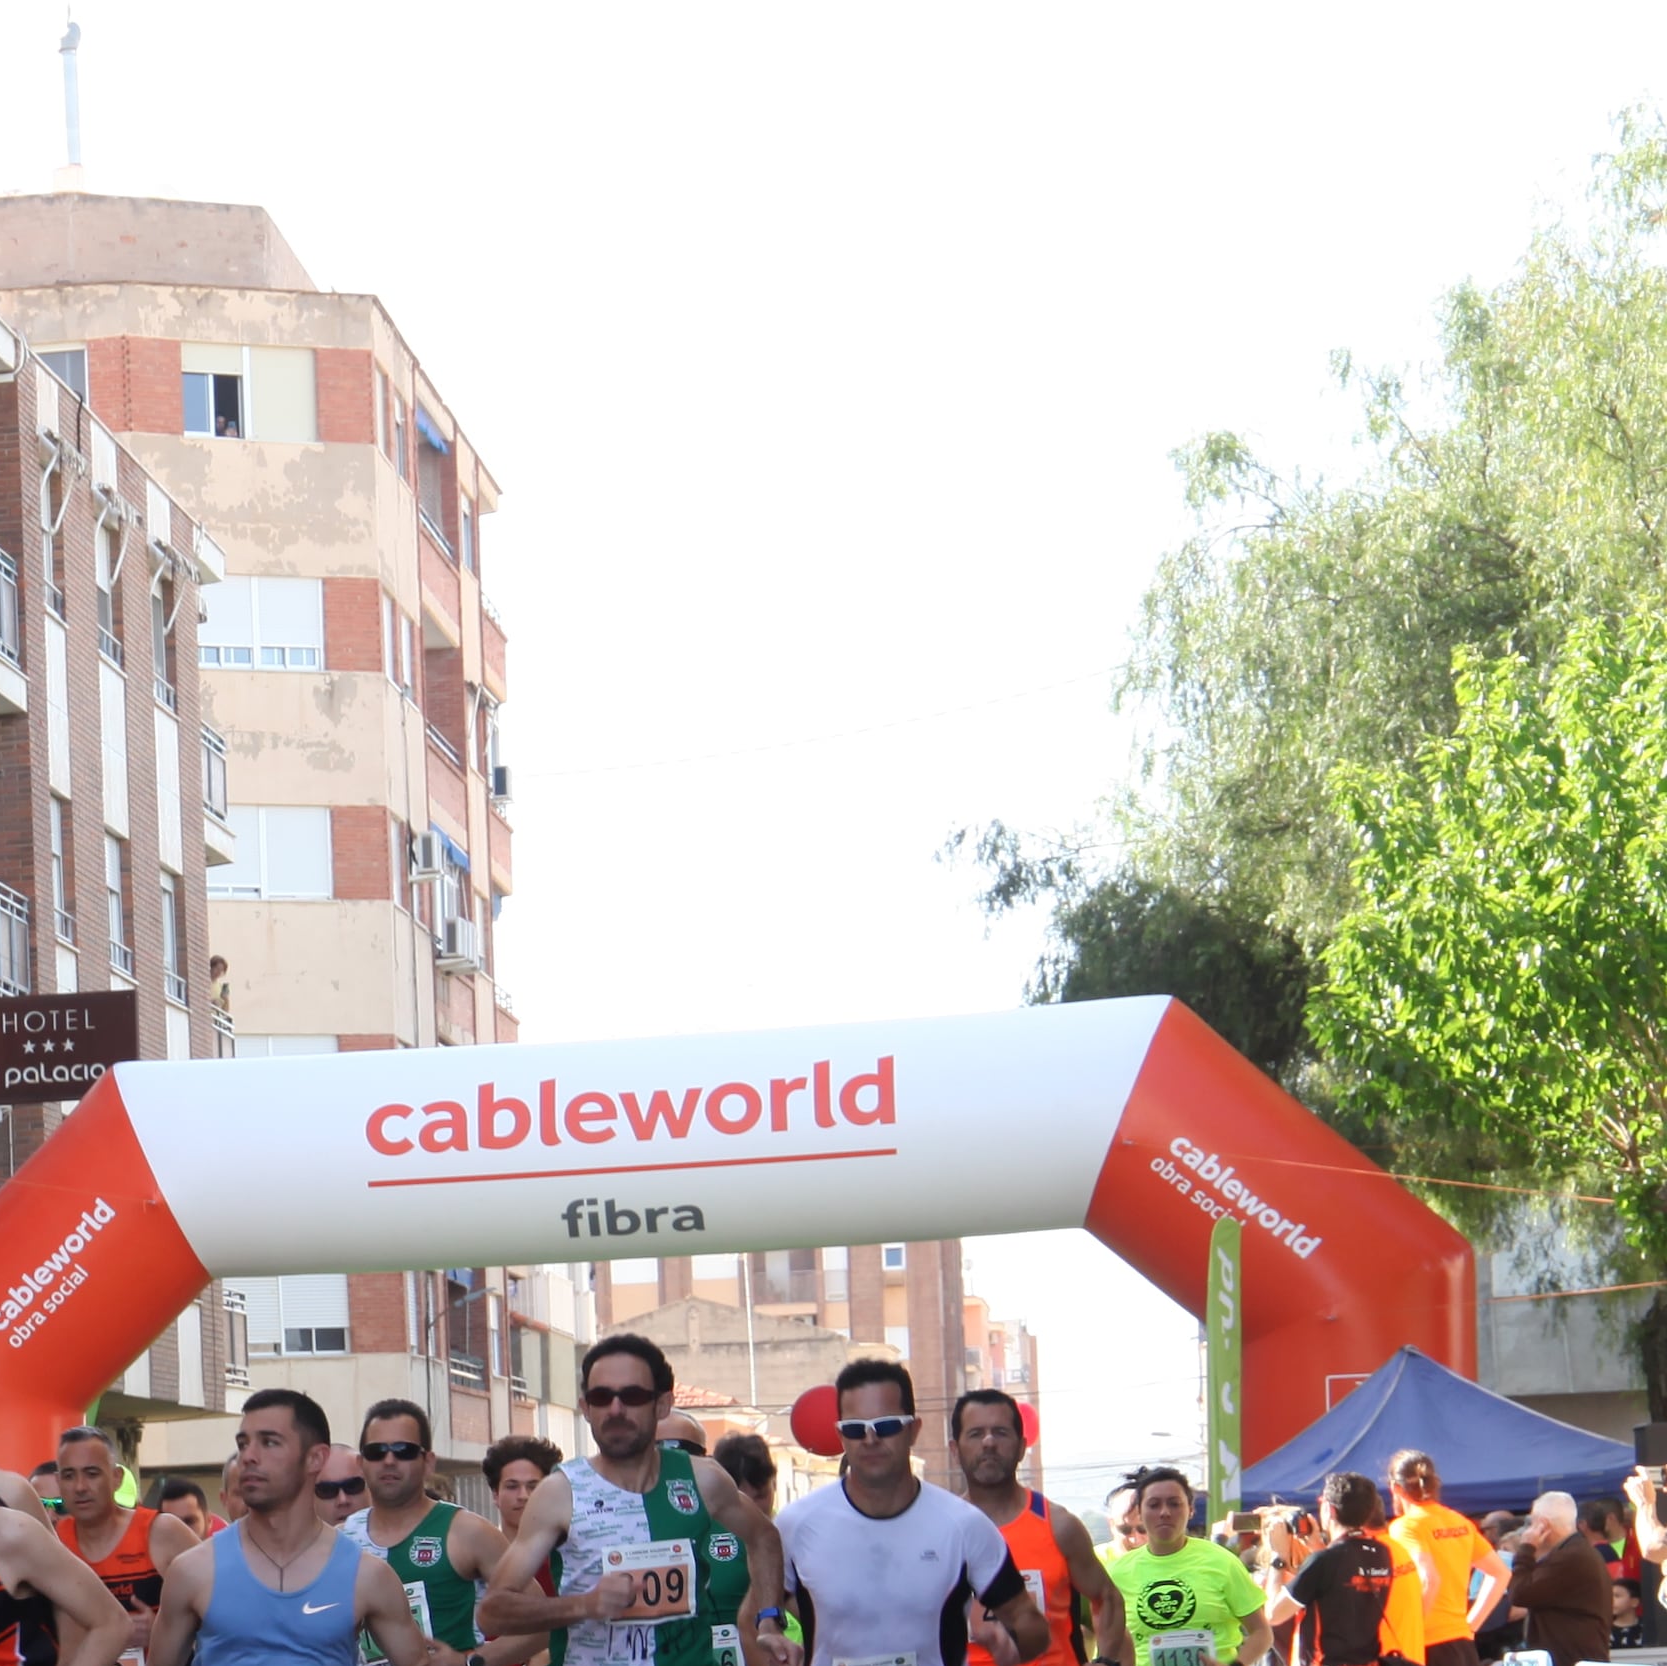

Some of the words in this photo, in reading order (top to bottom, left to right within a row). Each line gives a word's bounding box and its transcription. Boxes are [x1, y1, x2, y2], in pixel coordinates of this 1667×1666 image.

[2, 1008, 95, 1034] HOTEL
[4, 1061, 107, 1089] palacio
[366, 1055, 896, 1156] cableworld
[561, 1198, 705, 1238] fibra
[1150, 1157, 1193, 1194] obra
[1190, 1190, 1246, 1226] soci
[1170, 1137, 1322, 1259] cableworld
[9, 1311, 47, 1348] obra
[43, 1264, 89, 1313] social
[622, 1567, 684, 1608] 09
